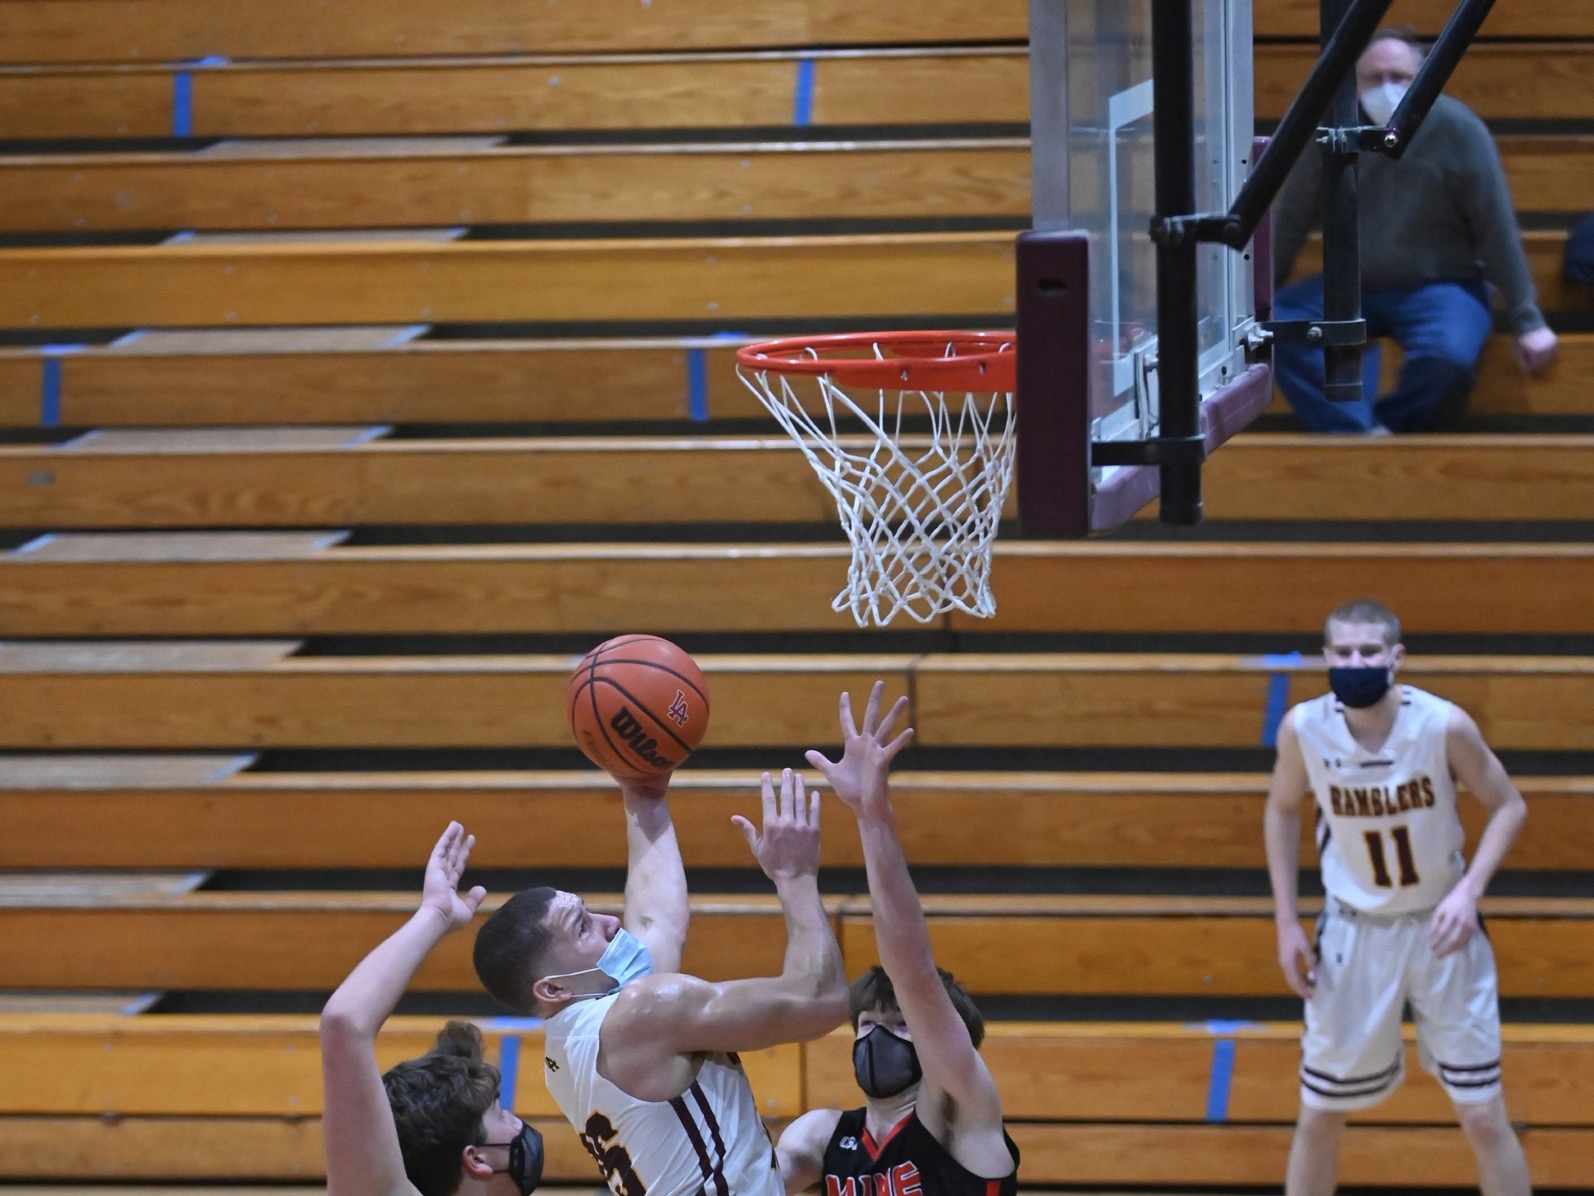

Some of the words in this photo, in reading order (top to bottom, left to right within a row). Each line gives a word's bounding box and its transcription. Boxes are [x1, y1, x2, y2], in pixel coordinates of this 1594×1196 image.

[667, 690, 689, 728] LA
[1329, 775, 1435, 816] RAMBLERS
[1363, 826, 1420, 888] 11
